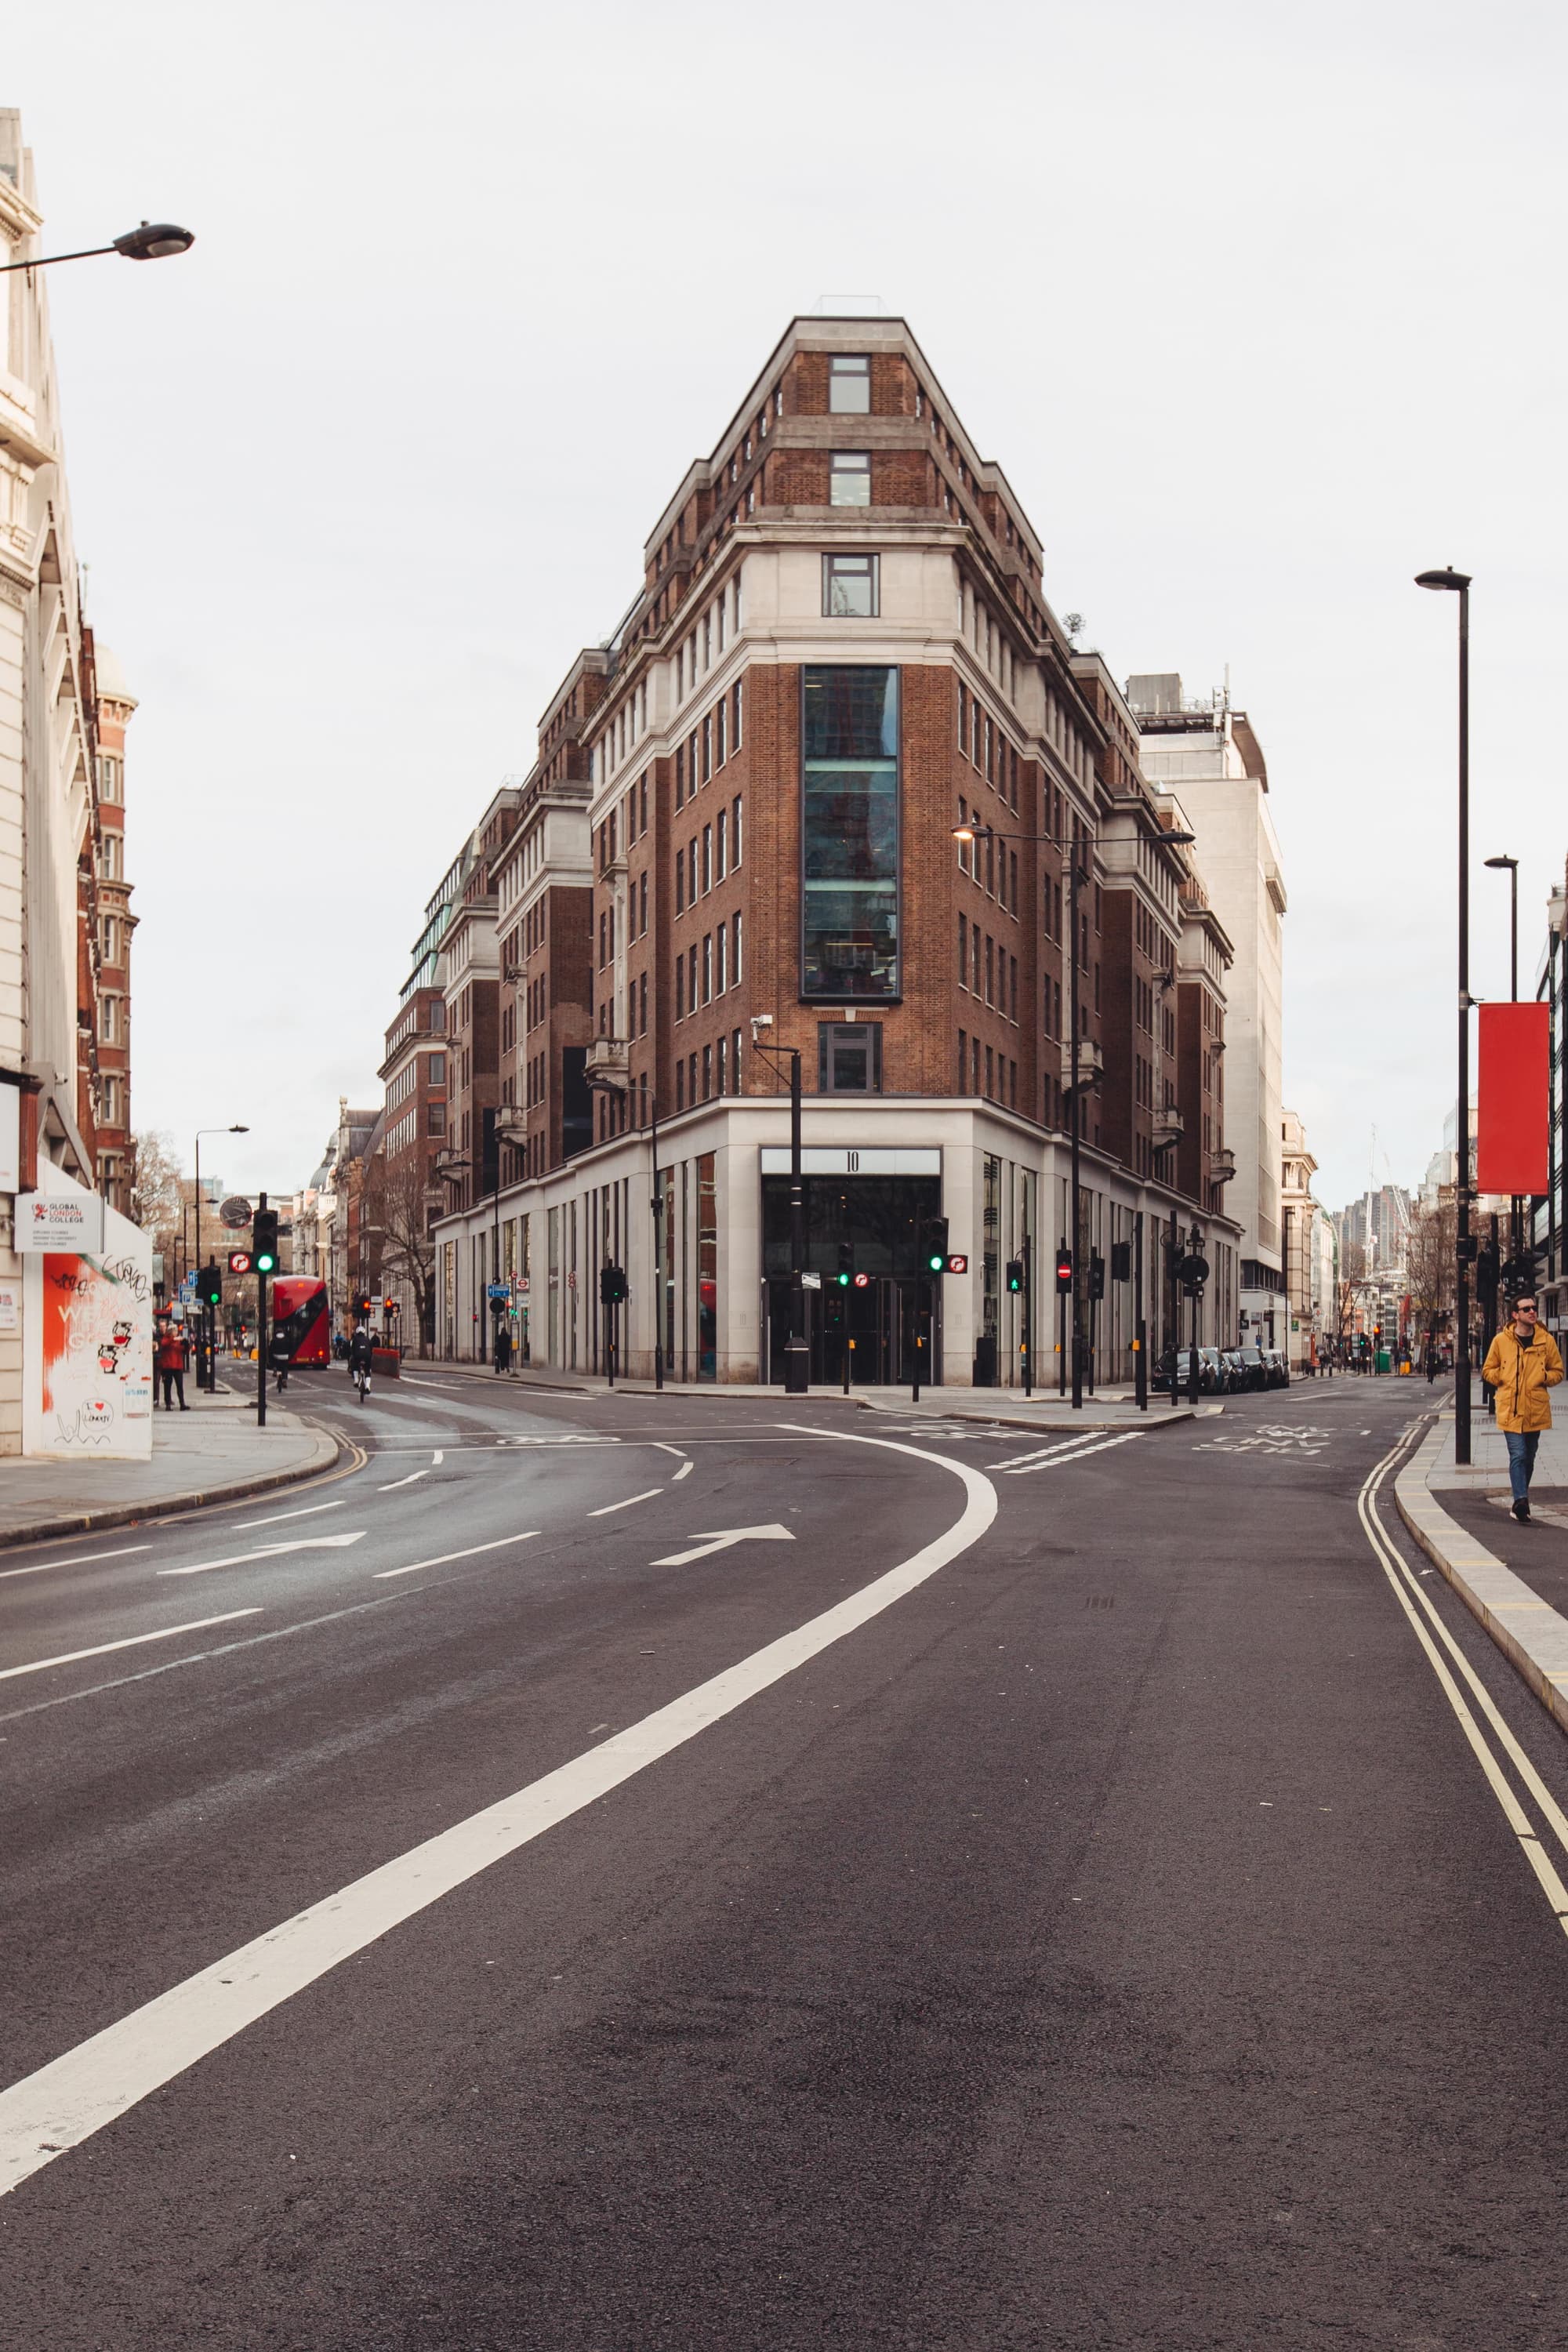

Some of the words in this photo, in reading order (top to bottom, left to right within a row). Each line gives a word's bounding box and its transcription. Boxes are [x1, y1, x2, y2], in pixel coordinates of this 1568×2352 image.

[847, 1151, 859, 1172] 10
[1213, 1436, 1331, 1447] AND
[1192, 1443, 1321, 1455] BUS
